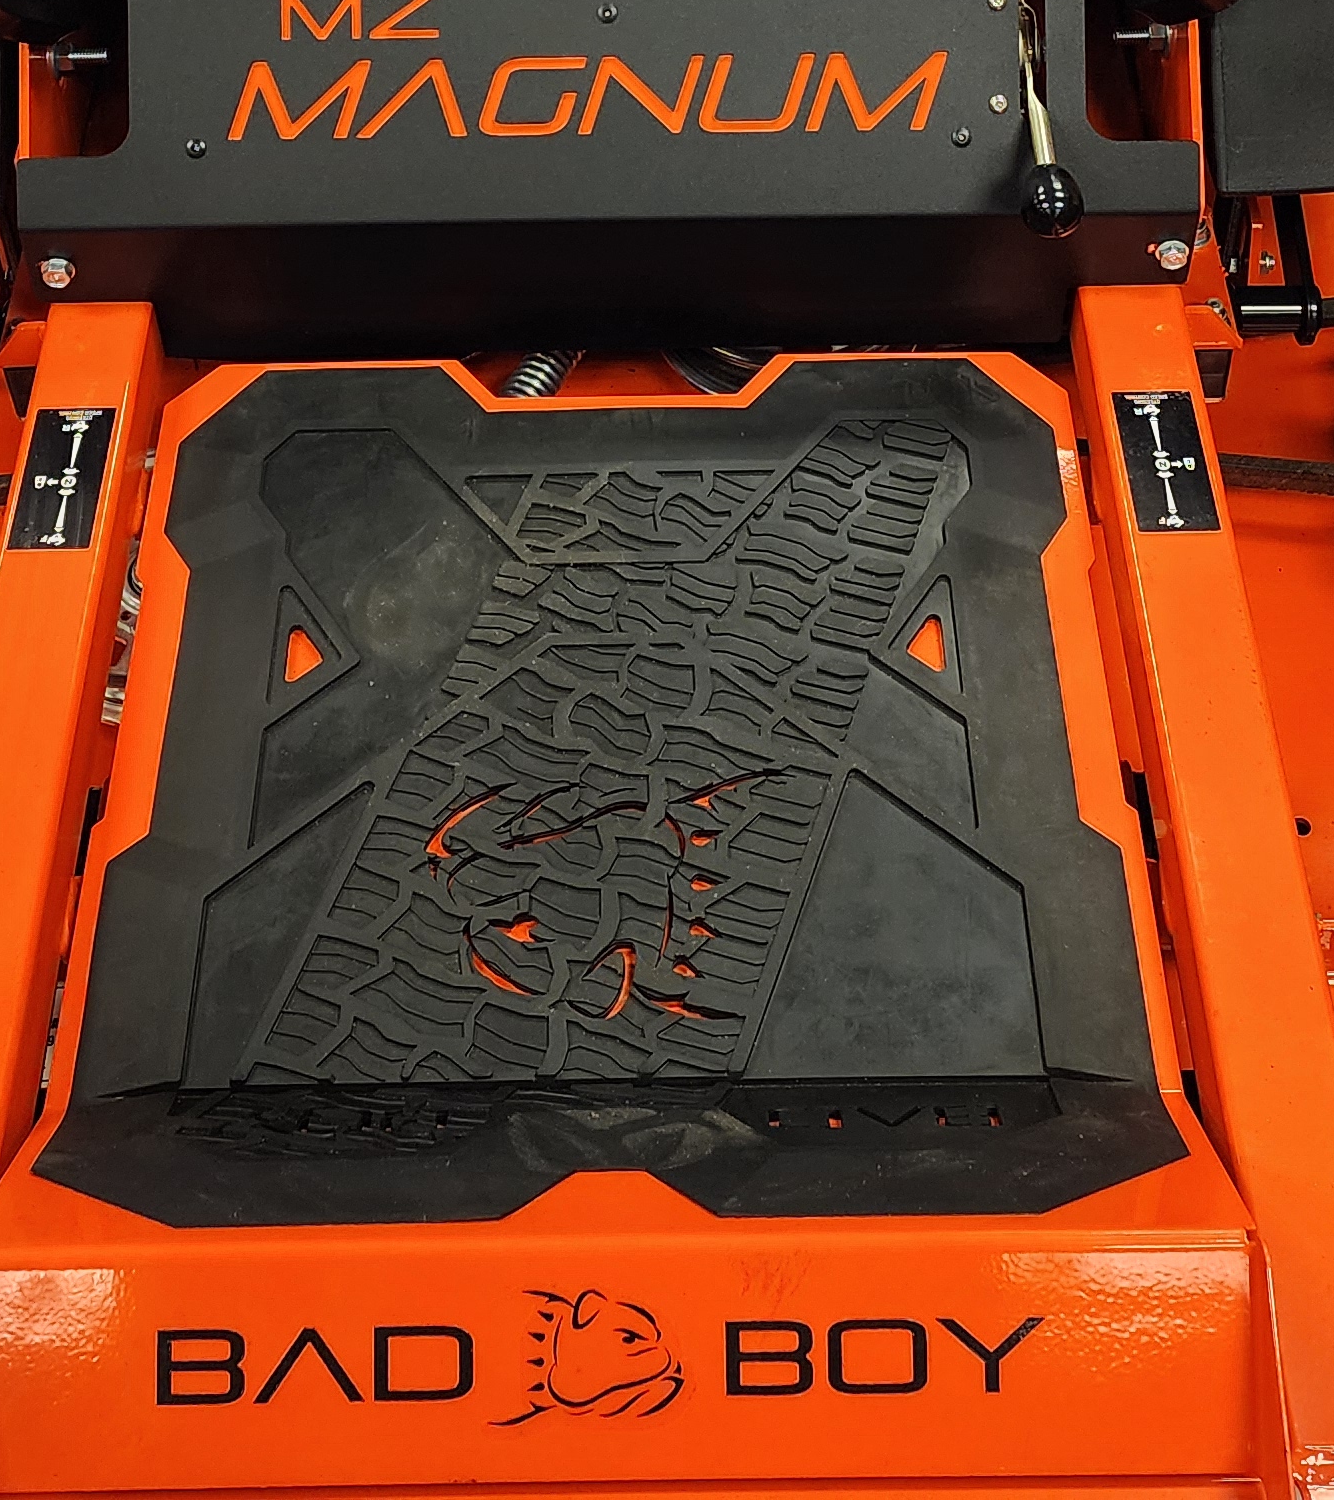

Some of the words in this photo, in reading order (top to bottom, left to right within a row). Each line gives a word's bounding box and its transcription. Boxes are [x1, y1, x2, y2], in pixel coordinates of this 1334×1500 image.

[227, 51, 948, 141] MAGNUM
[154, 1323, 475, 1406] BAD
[723, 1316, 1046, 1396] BOY
